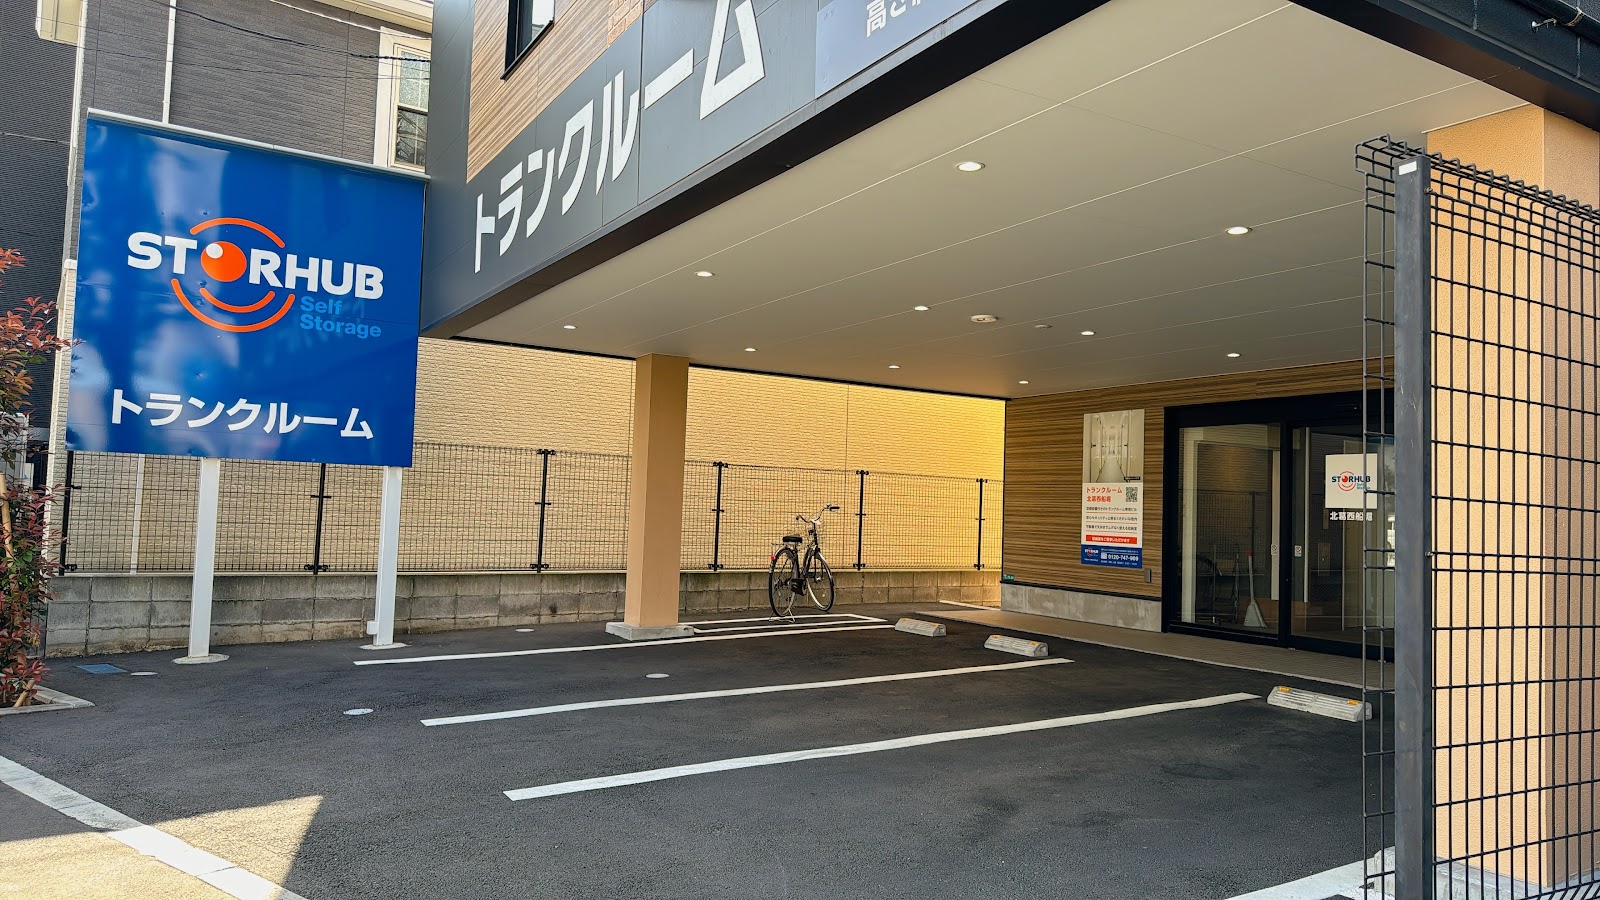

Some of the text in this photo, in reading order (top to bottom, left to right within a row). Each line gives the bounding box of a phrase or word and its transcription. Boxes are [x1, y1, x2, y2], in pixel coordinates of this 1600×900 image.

[866, 0, 921, 38] 高さ
[474, 0, 765, 273] トランクルーム
[127, 231, 384, 299] STORHUB
[299, 314, 382, 339] Storage
[300, 295, 342, 315] Self
[111, 389, 374, 440] トランクルーム
